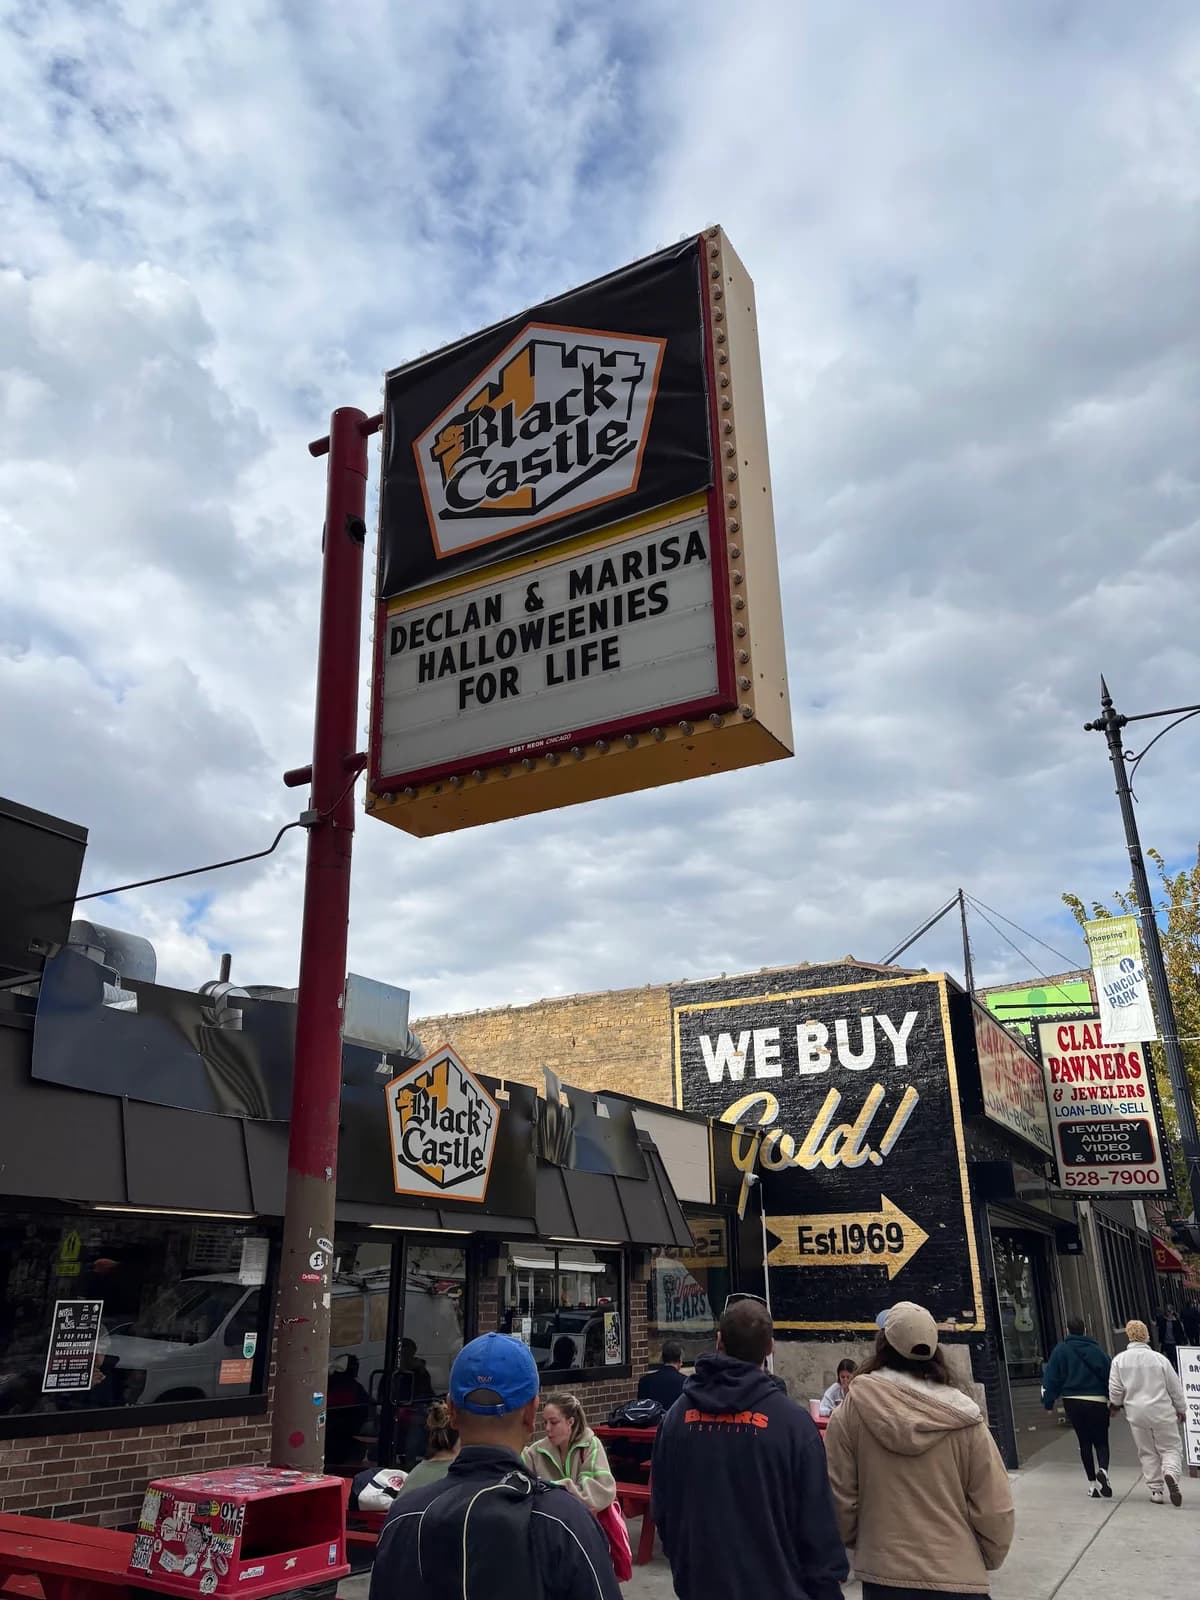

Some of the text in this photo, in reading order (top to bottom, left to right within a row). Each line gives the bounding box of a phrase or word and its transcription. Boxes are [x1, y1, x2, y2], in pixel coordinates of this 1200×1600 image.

[450, 362, 614, 458] Black
[446, 420, 630, 509] Castle
[390, 530, 707, 656] DECLAN & MARISA
[418, 581, 669, 683] HALLOWEENIES
[459, 635, 620, 710] FOR LIFE
[509, 733, 572, 754] BEST NEON CHICAGO
[1104, 969, 1144, 997] LINCOLN
[1109, 987, 1138, 1008] PARK
[700, 1011, 918, 1083] WE BUY
[1057, 1023, 1125, 1052] CLA
[1048, 1052, 1142, 1083] PAWNERS
[1053, 1084, 1145, 1101] & JEWELERS
[402, 1083, 480, 1137] Black
[1055, 1102, 1148, 1117] LOAN-BUY-SELL
[1067, 1123, 1140, 1134] JEWELRY
[1081, 1133, 1129, 1143] AUDIO
[402, 1127, 484, 1171] Castle
[1075, 1152, 1143, 1163] & MORE
[1083, 1143, 1130, 1152] VIDEO
[1065, 1169, 1159, 1186] 528-7900
[684, 1408, 769, 1429] BEARS
